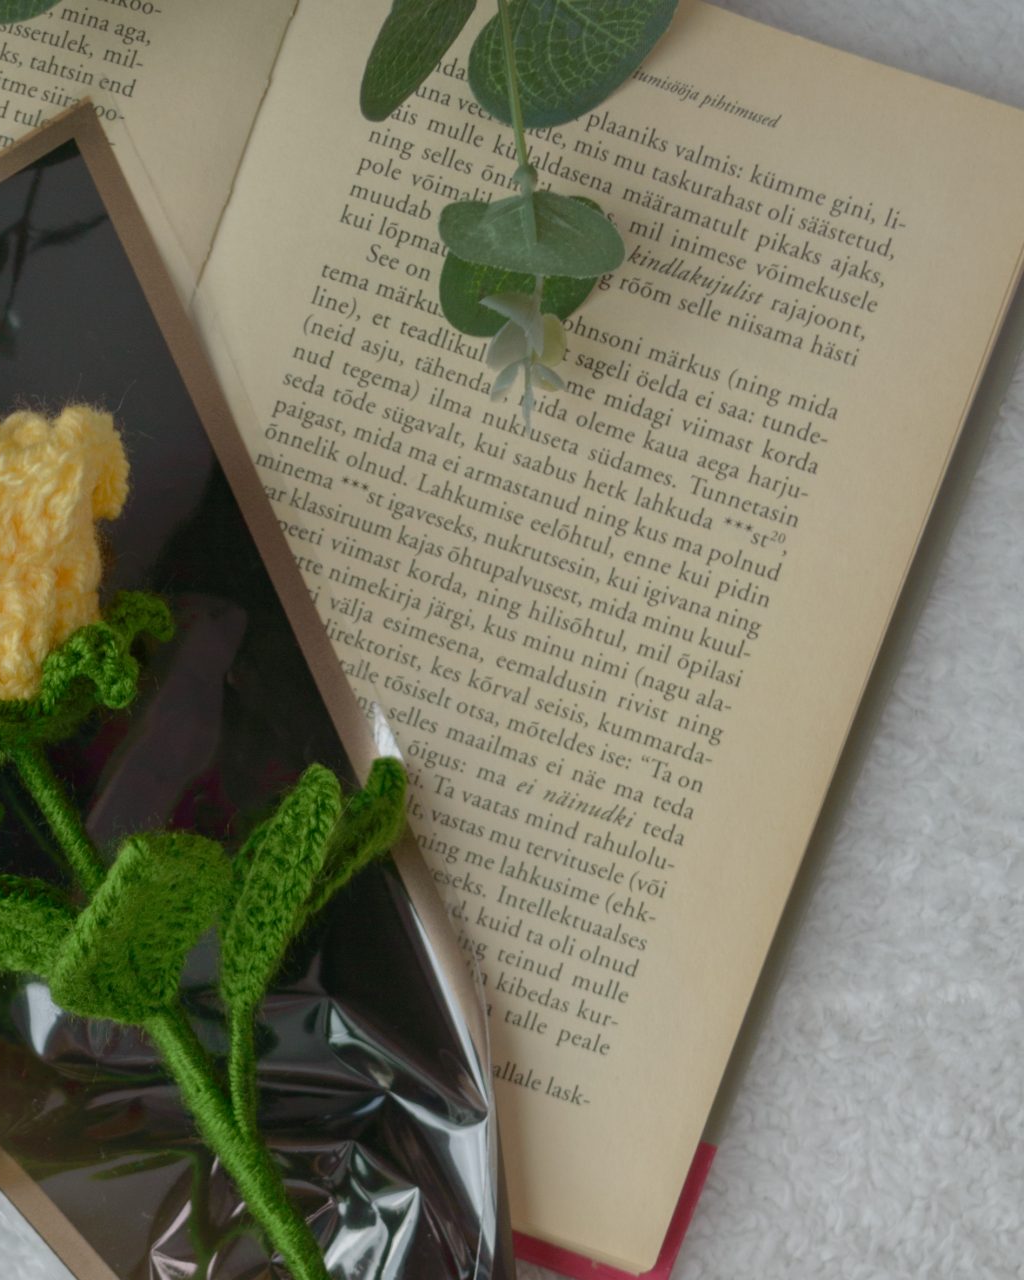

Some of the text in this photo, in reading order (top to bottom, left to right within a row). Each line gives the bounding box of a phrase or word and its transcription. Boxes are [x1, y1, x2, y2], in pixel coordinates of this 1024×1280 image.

[29, 54, 94, 86] tahtsin
[98, 77, 137, 99] end
[60, 6, 110, 33] mina
[113, 23, 151, 47] aga,
[102, 48, 144, 70] mil-
[631, 65, 783, 129] iumisööja pihtimused
[367, 127, 879, 313] ning selles mil inimese võimekusele
[572, 139, 895, 261] mis mu taskurahast oli säästetud,
[583, 107, 907, 230] plaaniks valmis: kümme gini, li-
[348, 184, 432, 221] muudab
[618, 276, 672, 306] rõõm
[677, 296, 722, 323] selle
[726, 312, 804, 350] niisama
[809, 333, 860, 367] hästi
[365, 243, 400, 271] See
[405, 263, 431, 282] on
[562, 309, 644, 356] ohnsoni
[647, 347, 721, 382] märkus
[727, 368, 782, 408] (ning
[787, 393, 839, 421] mida
[270, 399, 783, 582] paigast, mida ma ei armastanud ning kus ma polnud
[282, 373, 325, 398] seda
[332, 388, 377, 415] tõde
[381, 406, 465, 449] sügavalt,
[473, 431, 509, 461] kui
[512, 453, 577, 484] saabus
[582, 469, 628, 502] hetk
[633, 486, 713, 531] lahkuda
[292, 346, 335, 370] nud
[341, 361, 420, 402] tegema)
[428, 386, 472, 419] ilma
[587, 447, 677, 489] südames.
[690, 474, 799, 529] Tunnetasin
[255, 453, 334, 491] minema
[386, 492, 478, 543] igaveseks,
[483, 532, 601, 584] nukrutsesin,
[605, 566, 641, 595] kui
[642, 579, 712, 619] igivana
[715, 608, 762, 640] ning
[264, 423, 770, 609] õnnelik olnud. Lahkumise eelõhtul, enne kui pidin
[330, 597, 725, 746] välja esimesena, eemaldusin rivist ning
[331, 536, 744, 688] viimast korda, ning hilisõhtul, mil õpilasi
[383, 675, 453, 710] tõsiselt
[455, 701, 500, 728] otsa,
[506, 717, 596, 757] mõteldes
[599, 743, 632, 770] ise:
[677, 775, 704, 794] on
[406, 739, 685, 847] õigus: ma ei näinudki teda
[431, 809, 668, 899] vastas mu tervitusele (või
[496, 884, 648, 952] Intellektuaalses
[497, 949, 630, 1004] teinud mulle
[492, 1060, 590, 1106] allale lask-
[504, 1009, 611, 1056] talle peale
